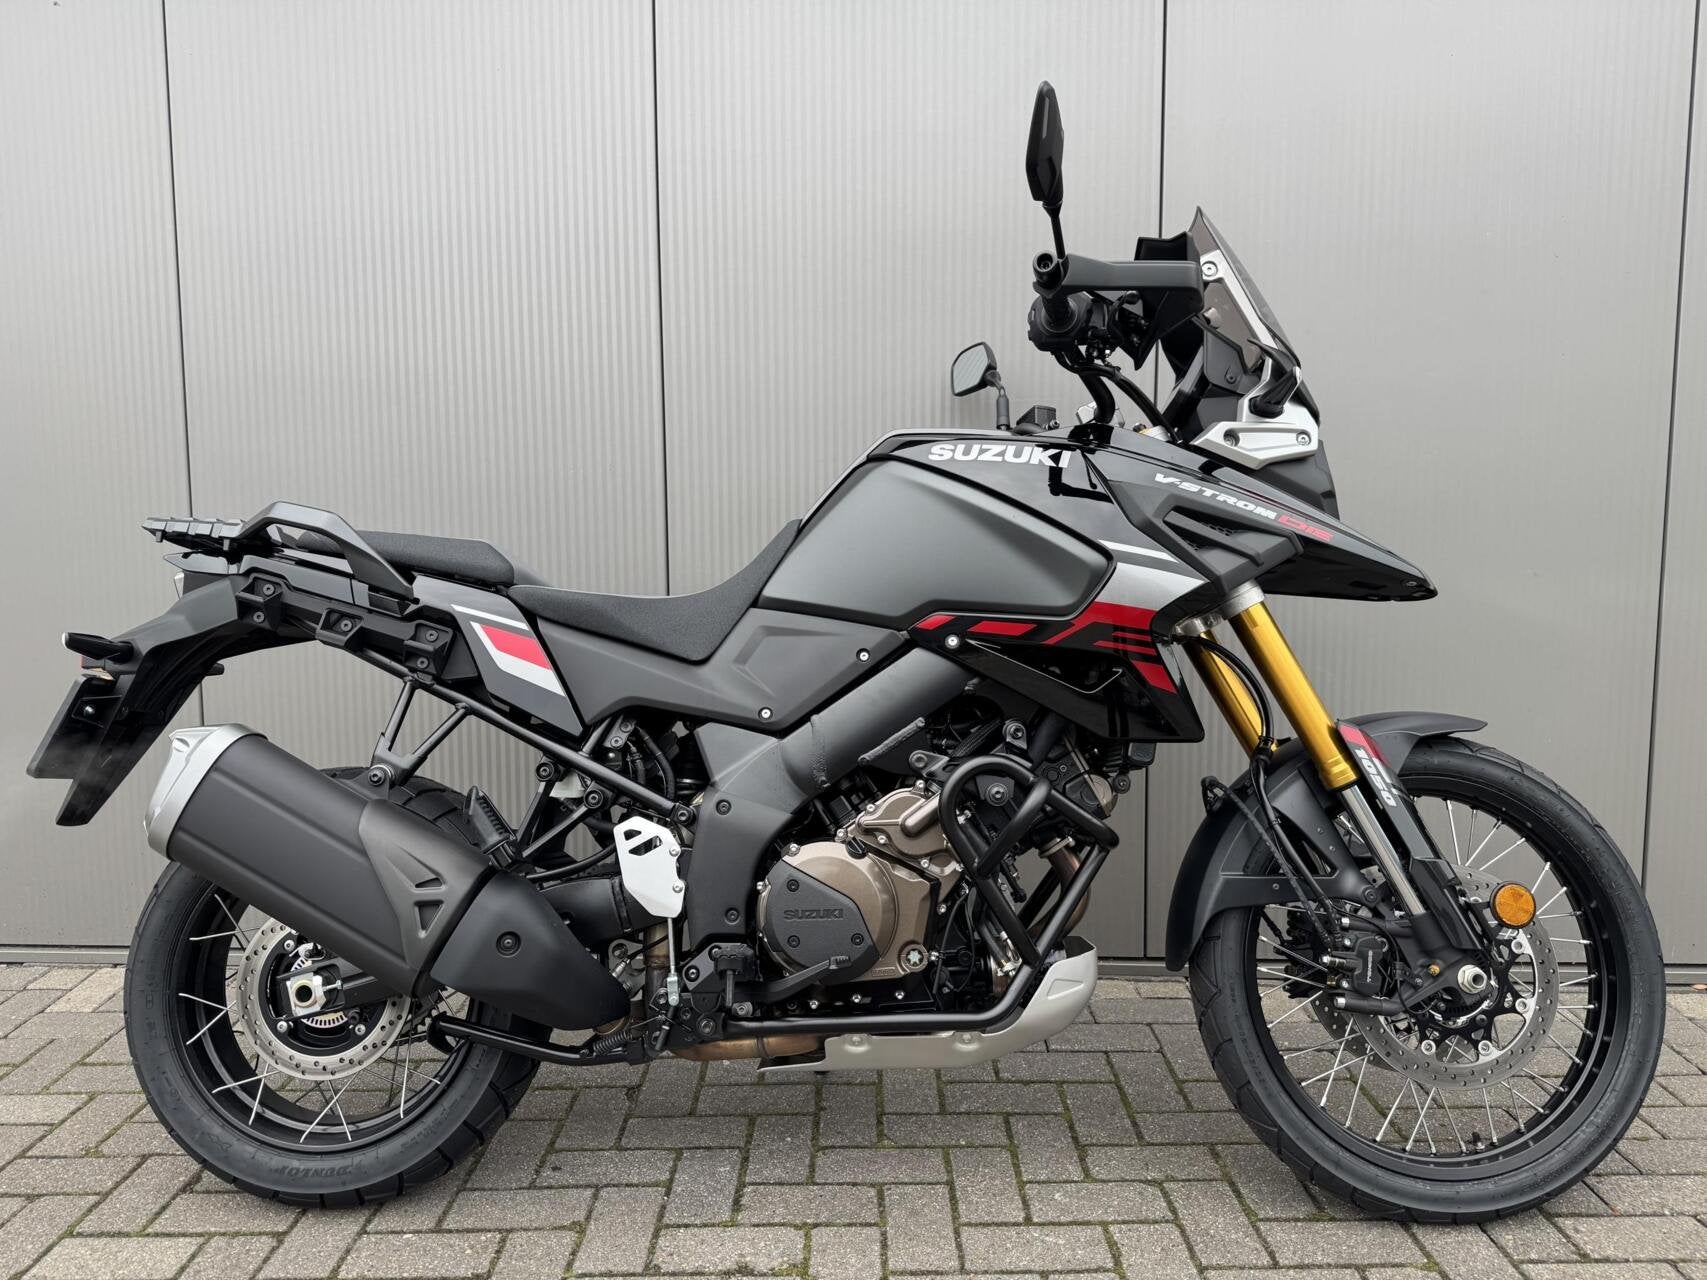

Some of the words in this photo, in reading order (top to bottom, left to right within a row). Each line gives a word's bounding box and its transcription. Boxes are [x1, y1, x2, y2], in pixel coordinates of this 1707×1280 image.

[928, 443, 1072, 468] SUZUKI
[1154, 473, 1278, 520] V-STROM
[1278, 515, 1335, 542] DE
[1354, 748, 1397, 807] 1050
[783, 907, 844, 921] SUZUKI
